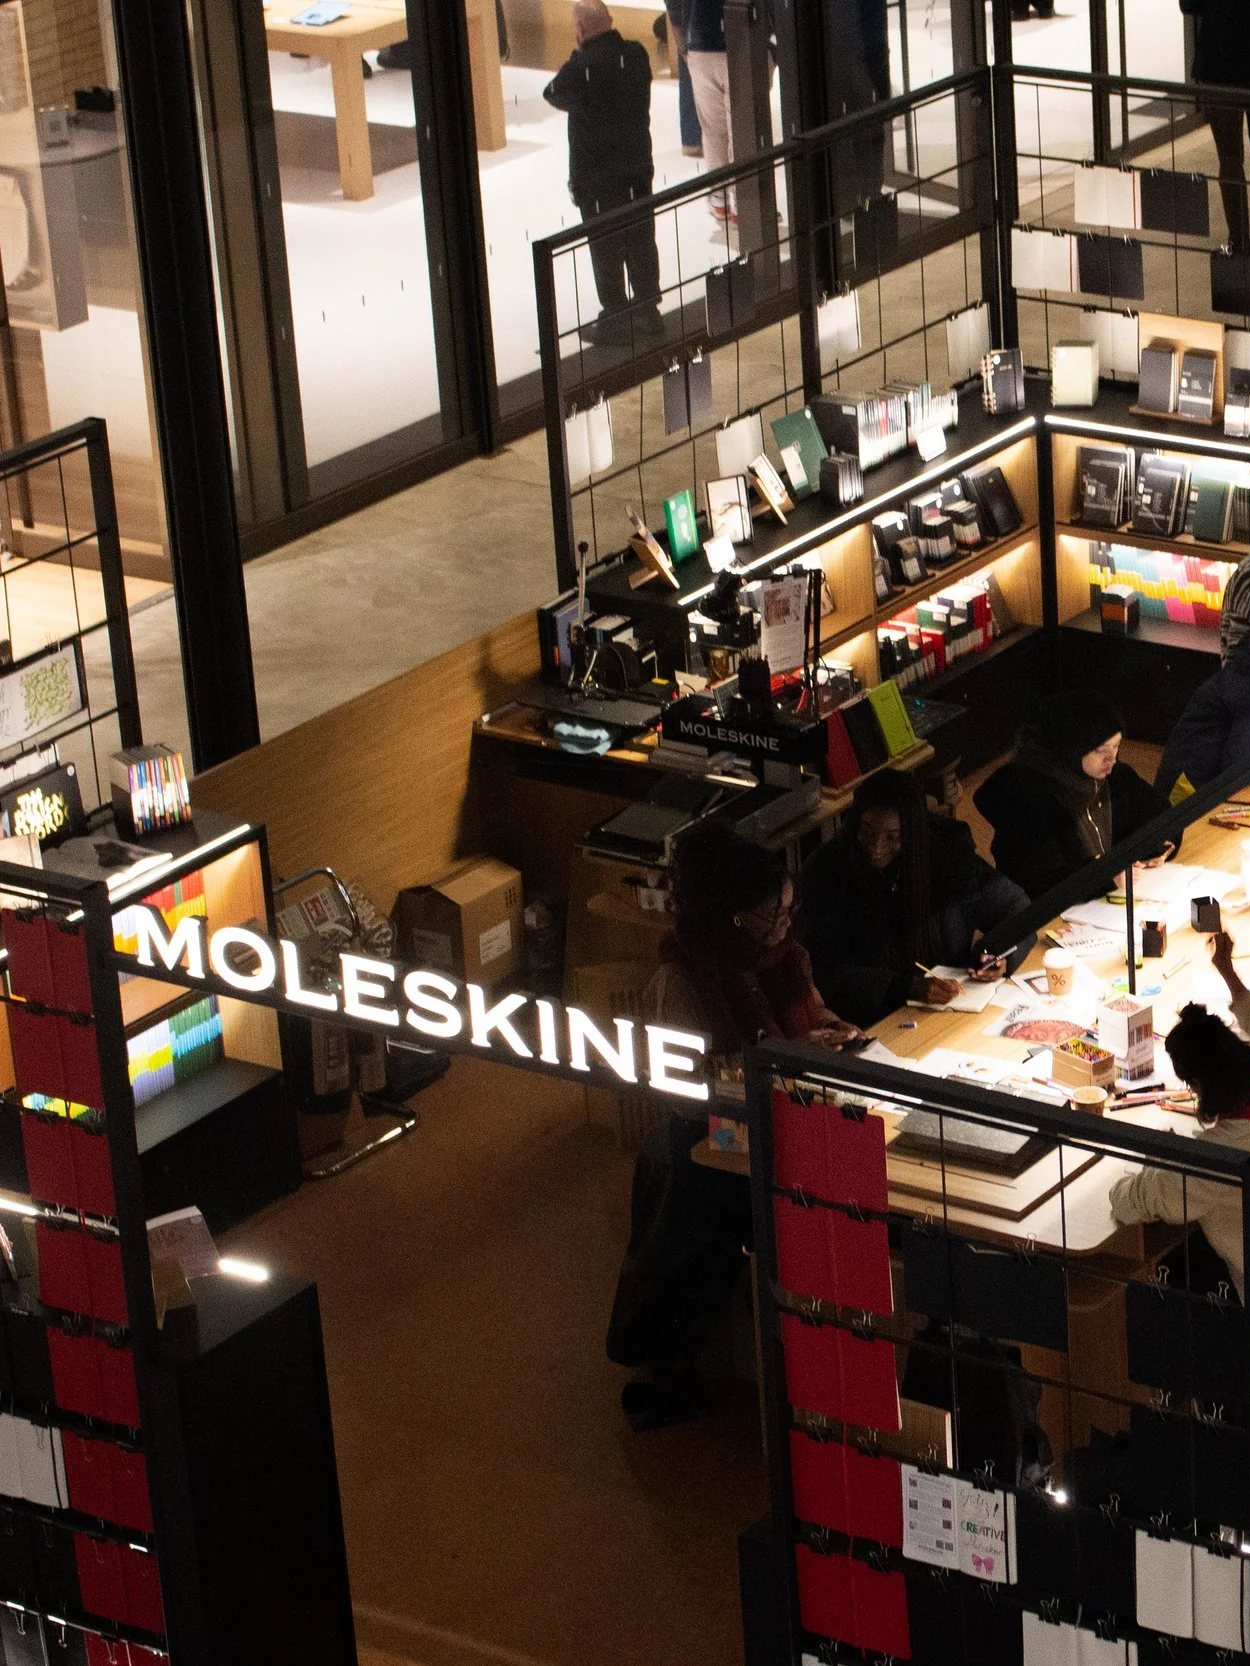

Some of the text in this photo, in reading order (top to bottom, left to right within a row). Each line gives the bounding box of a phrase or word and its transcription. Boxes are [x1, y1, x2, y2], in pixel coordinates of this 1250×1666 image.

[680, 720, 780, 751] MOLESKINE
[135, 905, 709, 1100] MOLESKINE
[961, 1519, 1006, 1541] CREATIVE
